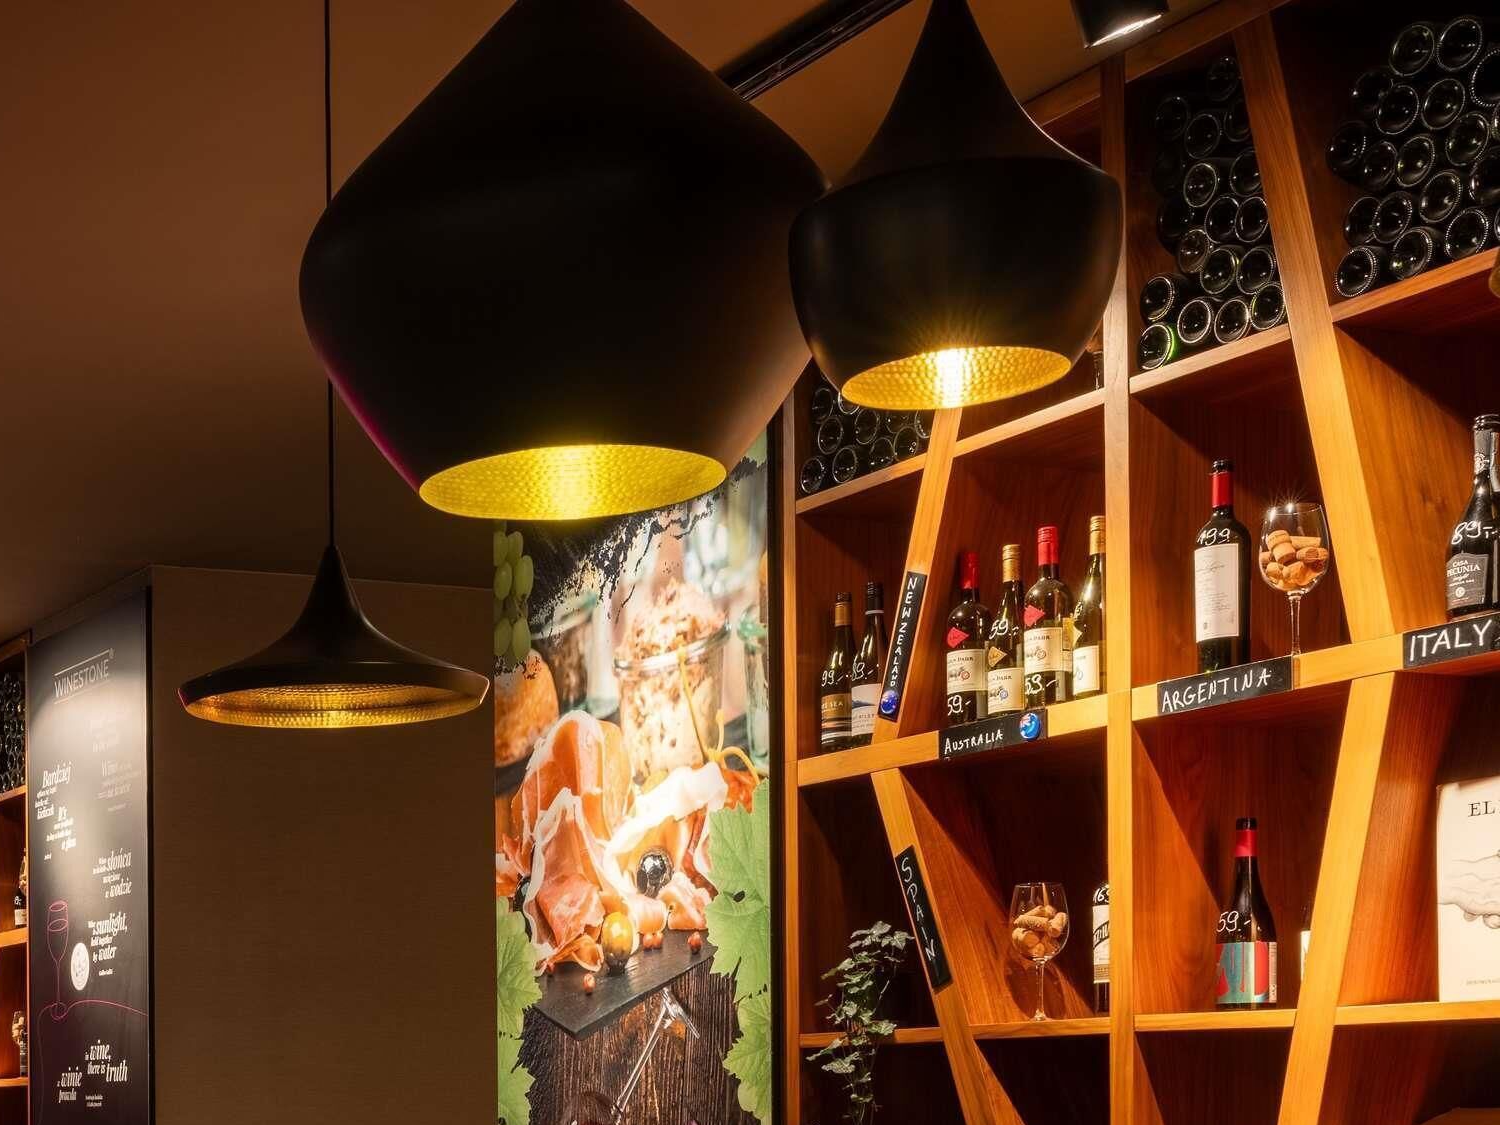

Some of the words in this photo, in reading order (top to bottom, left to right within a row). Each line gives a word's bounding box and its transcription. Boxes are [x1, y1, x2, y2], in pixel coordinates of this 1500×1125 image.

[901, 576, 919, 619] NEW
[888, 622, 908, 688] ZEALAND
[1409, 619, 1492, 663] ITALY
[54, 658, 110, 699] WINESTONE
[1161, 668, 1272, 713] ARGENTINA
[944, 729, 1005, 756] AUSTRALIA
[1467, 800, 1495, 818] EL
[901, 856, 937, 962] SPAIN
[106, 1059, 128, 1082] truth
